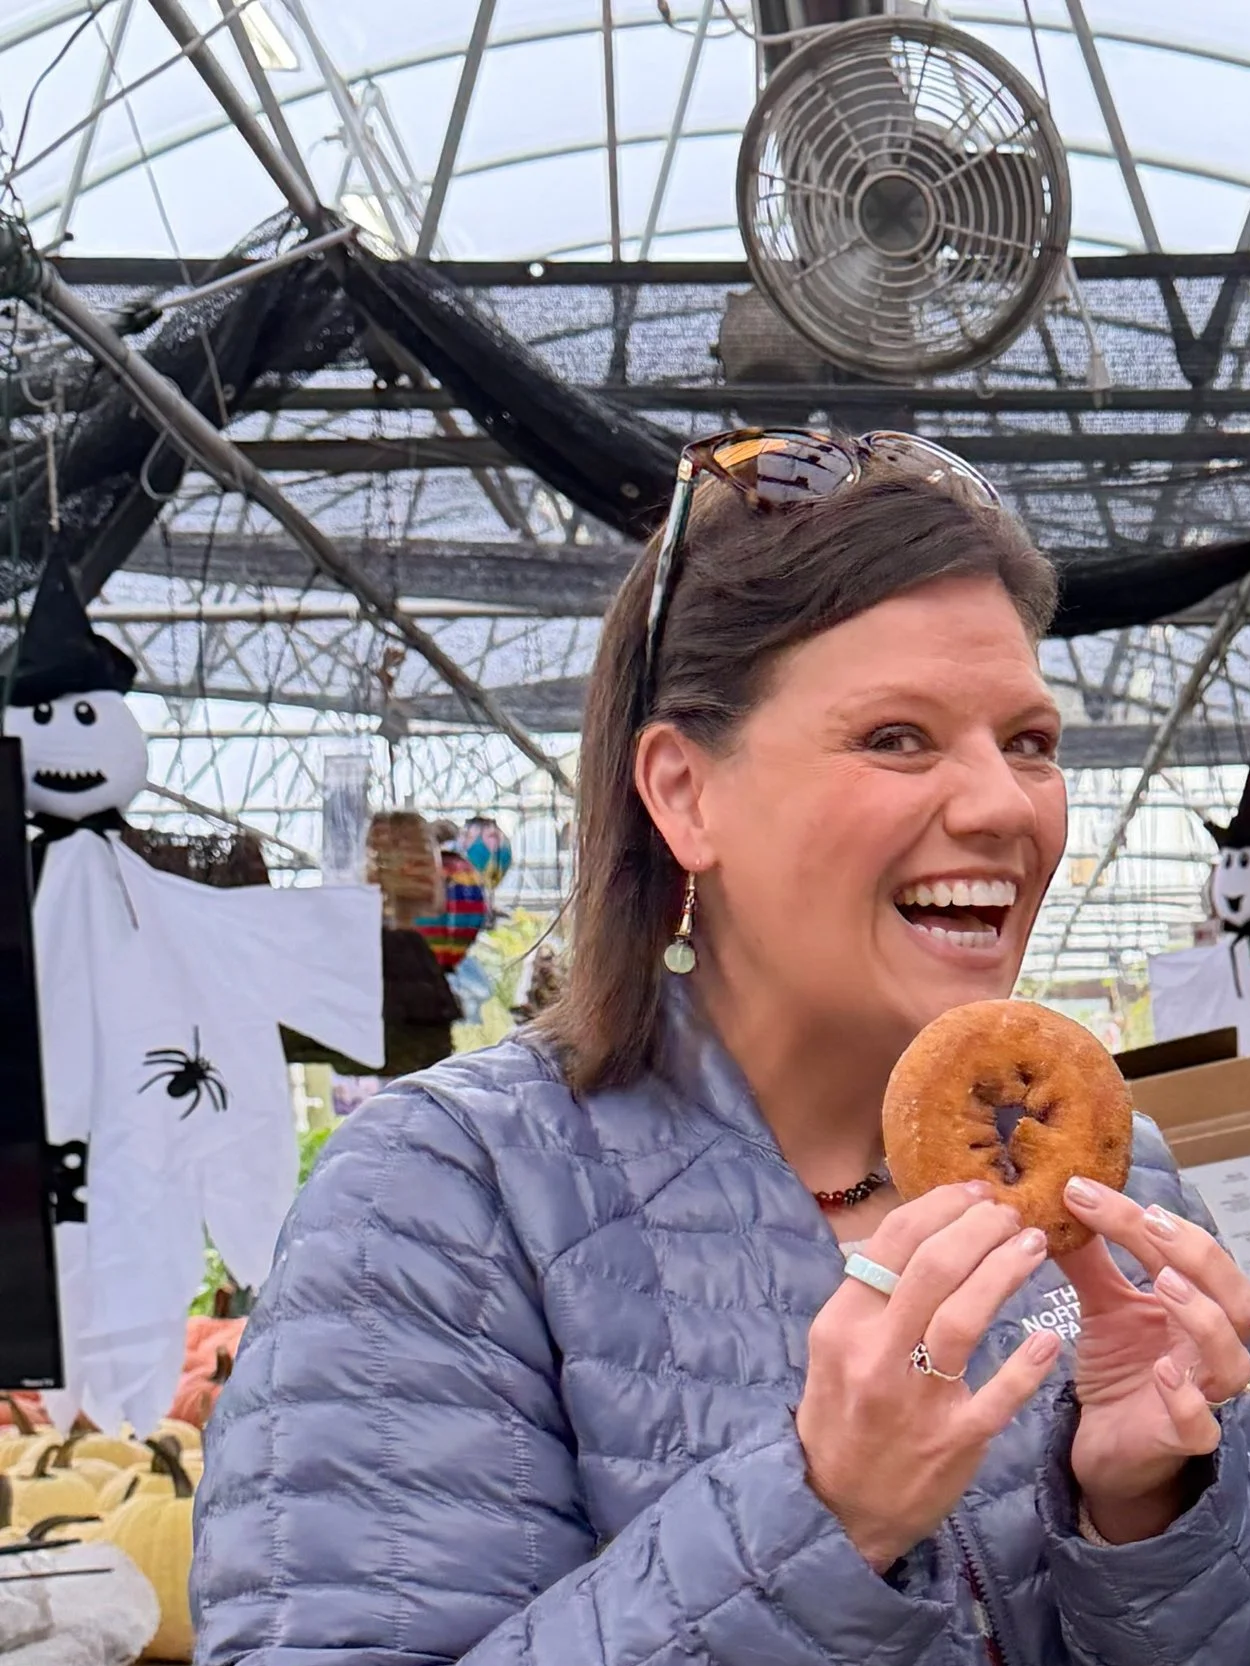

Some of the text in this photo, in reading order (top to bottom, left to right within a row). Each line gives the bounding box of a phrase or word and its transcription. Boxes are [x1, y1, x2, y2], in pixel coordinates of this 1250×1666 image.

[1043, 1284, 1079, 1306] TH
[1021, 1301, 1082, 1334] NORT
[1055, 1320, 1082, 1341] FA
